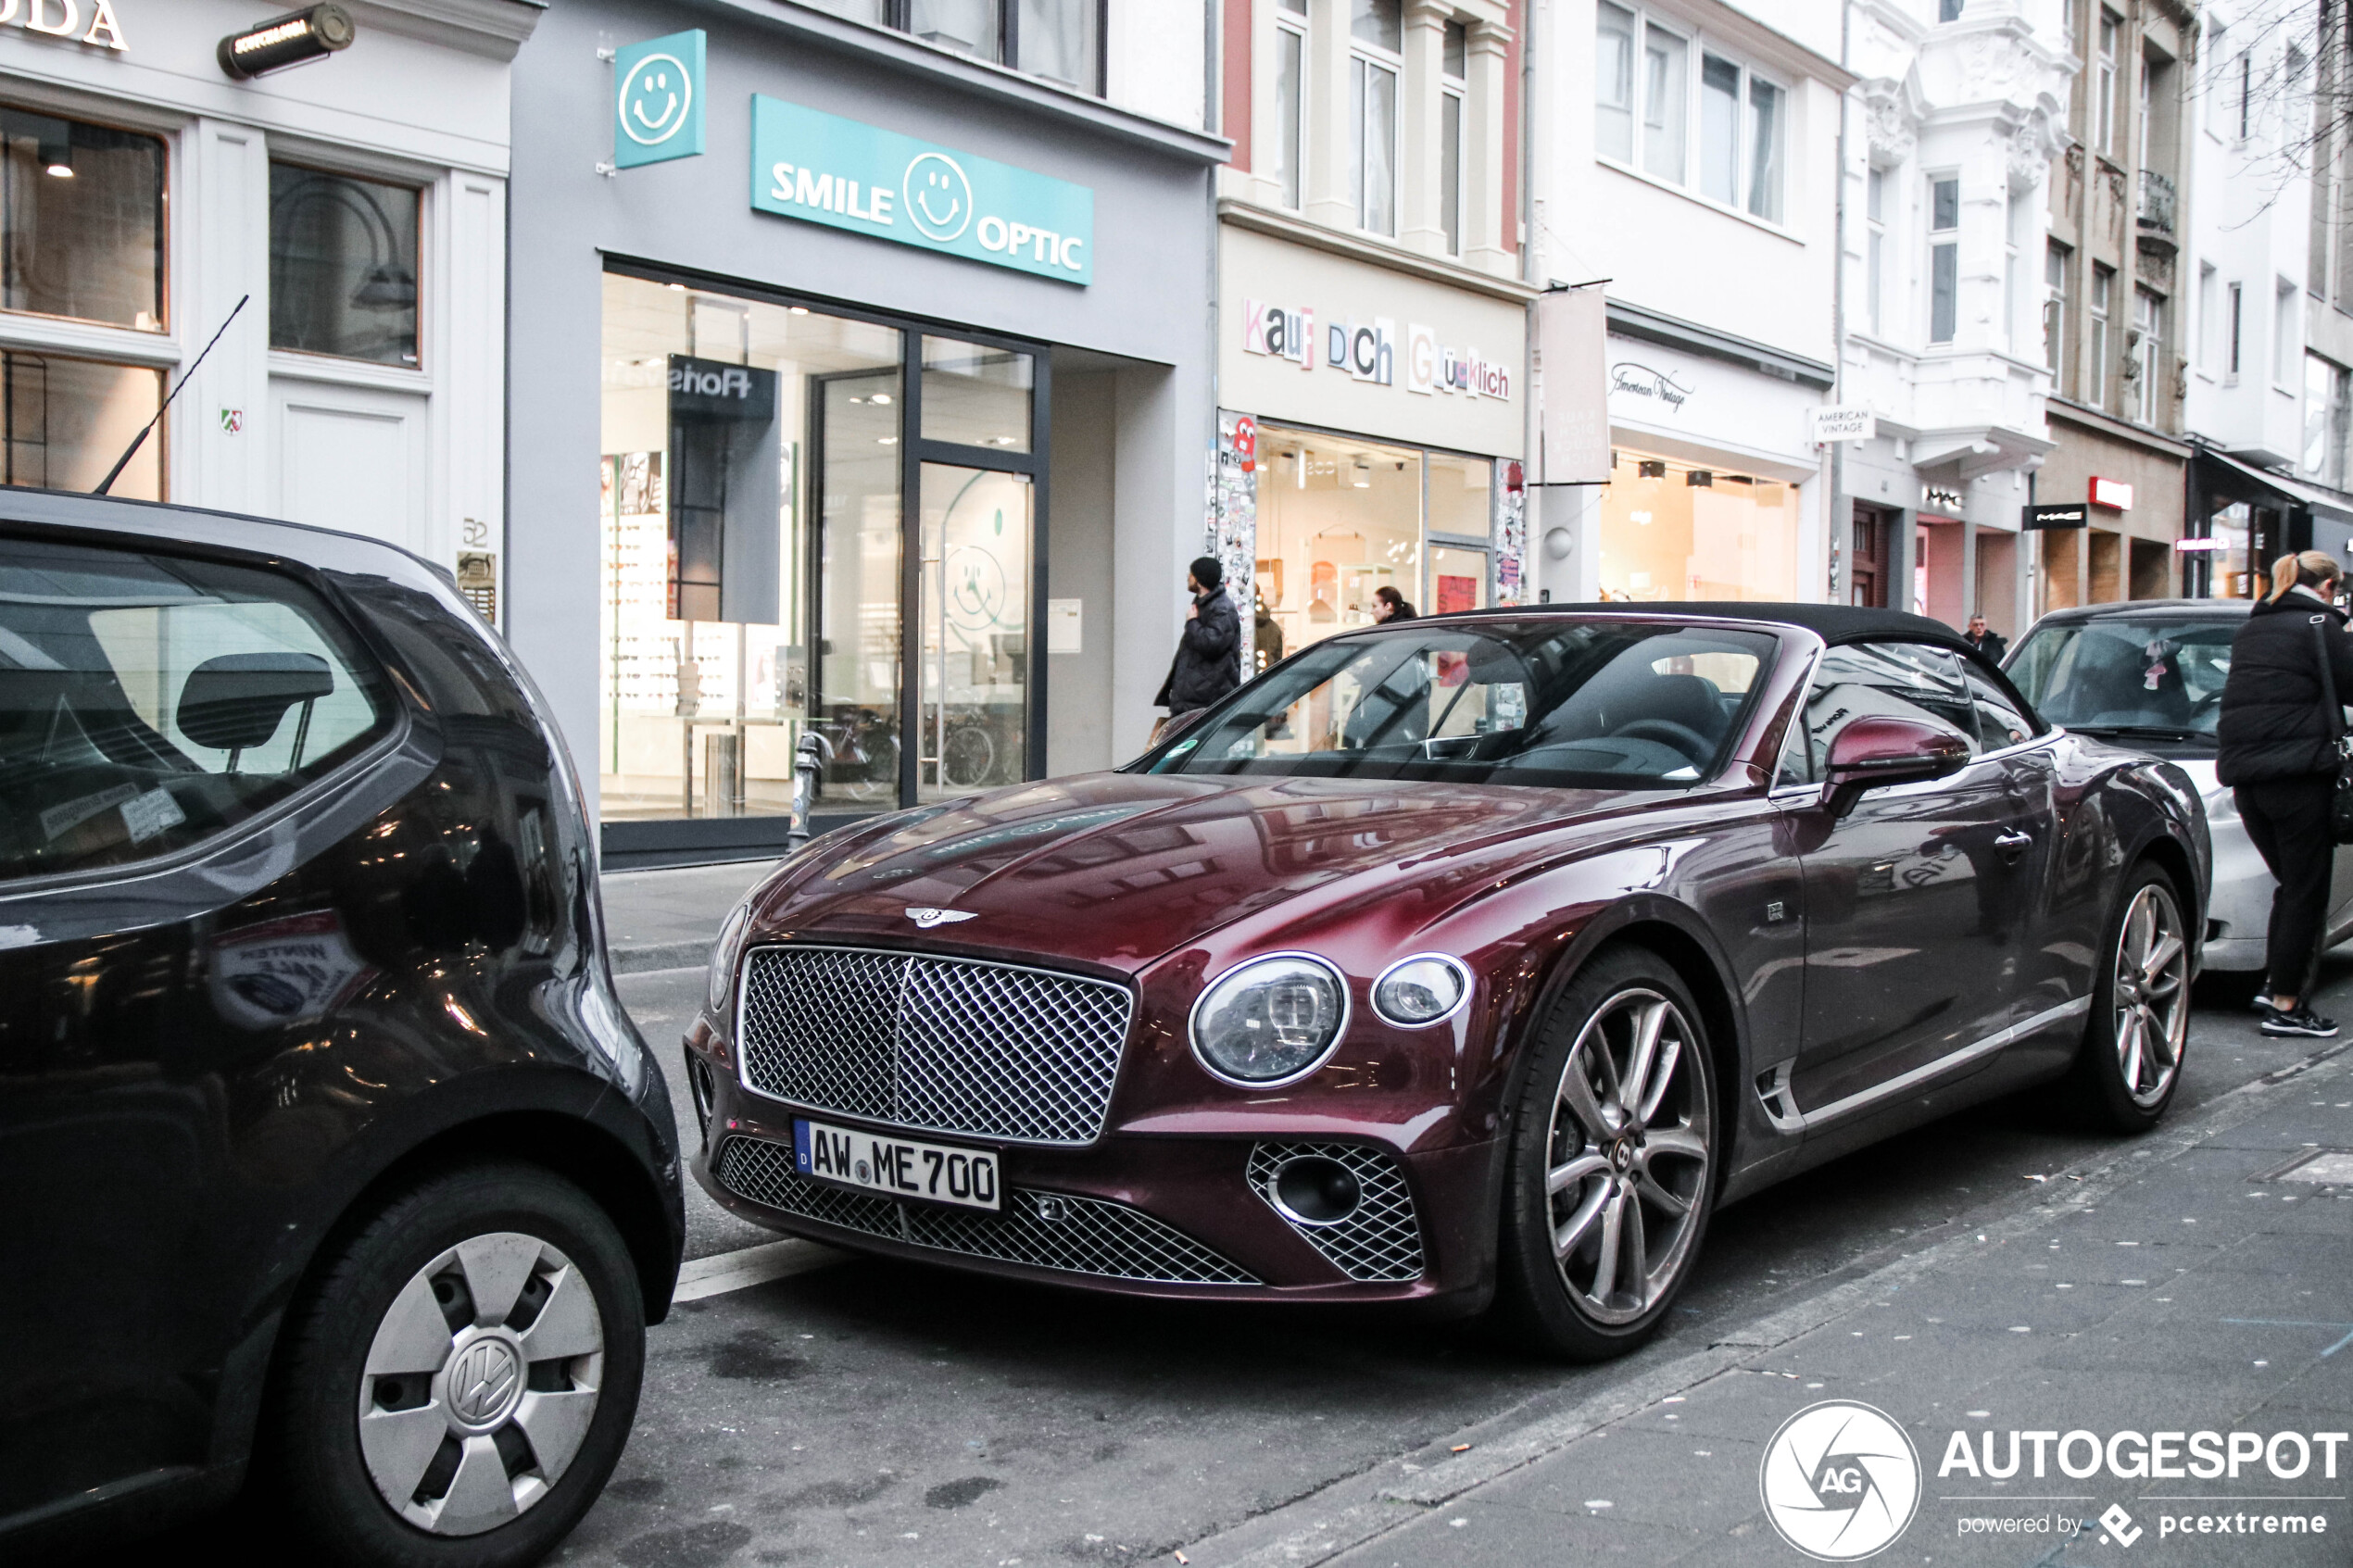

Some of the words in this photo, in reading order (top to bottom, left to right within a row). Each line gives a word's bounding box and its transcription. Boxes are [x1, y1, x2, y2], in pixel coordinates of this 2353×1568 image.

[772, 162, 895, 225] SMILE
[976, 216, 1083, 270] OPTIC
[1608, 367, 1653, 397] American
[1654, 370, 1685, 413] Vintage
[1818, 410, 1869, 423] AMERICAN
[1822, 421, 1863, 434] VINTAGE
[463, 518, 487, 546] 52
[813, 1129, 851, 1178] AW
